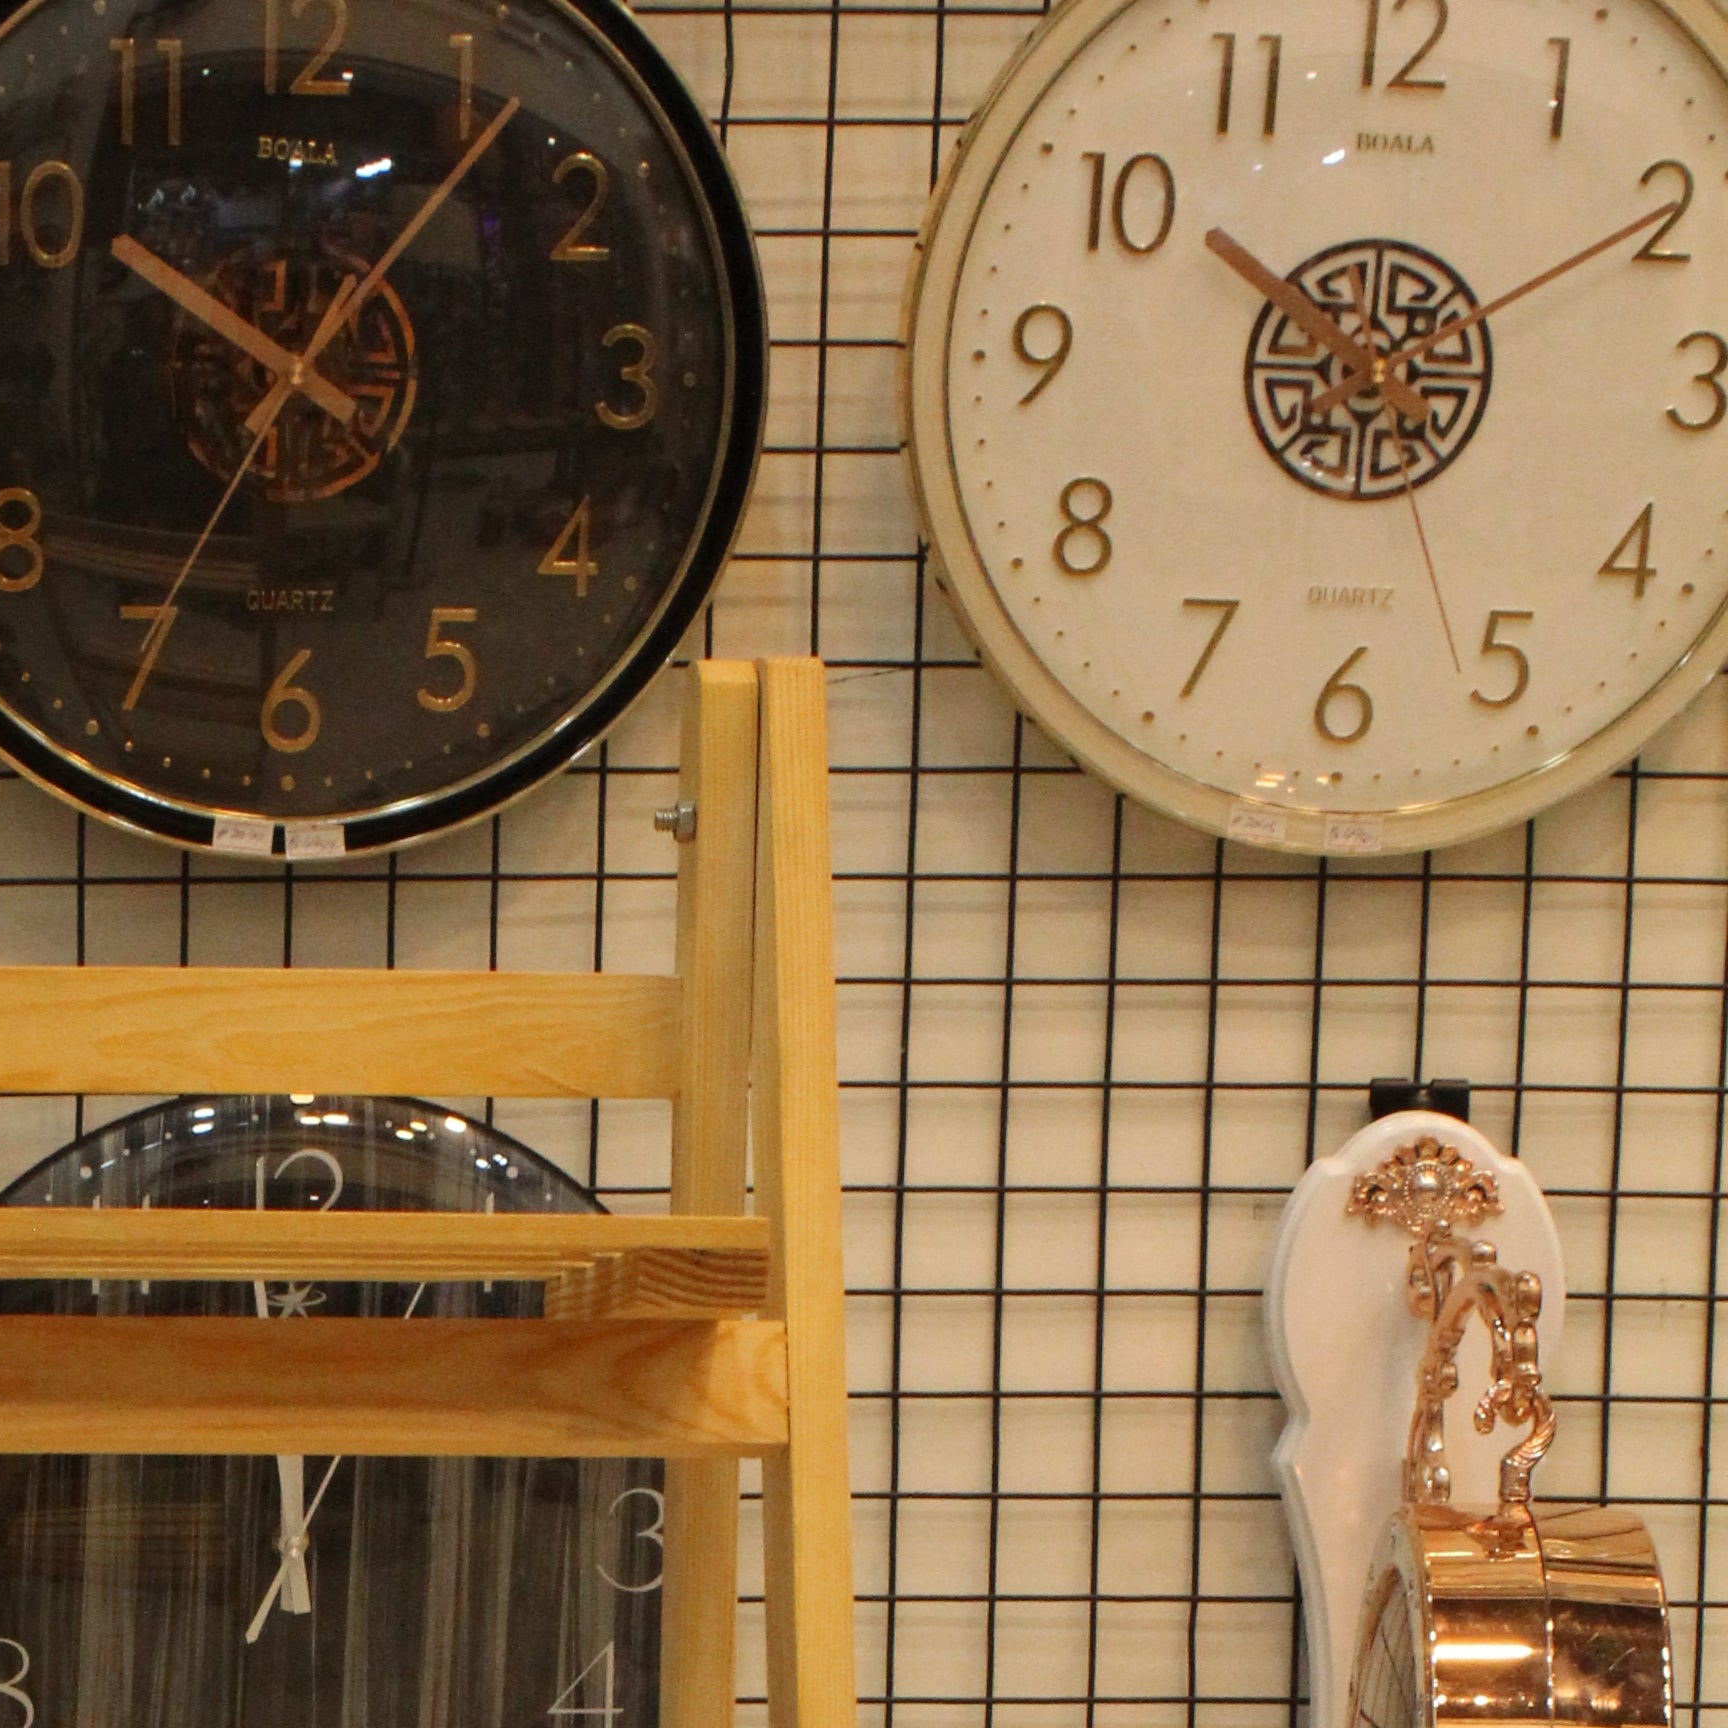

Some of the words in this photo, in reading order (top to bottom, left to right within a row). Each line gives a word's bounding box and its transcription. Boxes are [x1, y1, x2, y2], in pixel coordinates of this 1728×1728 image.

[109, 36, 185, 148] 11
[260, 0, 352, 97] 12
[447, 32, 475, 142] 1
[1210, 31, 1284, 140] 11
[1359, 0, 1449, 91] 12
[1544, 37, 1573, 142] 1
[1354, 131, 1436, 157] BOALA
[550, 151, 612, 264] 2
[1081, 150, 1177, 257] 10
[1630, 158, 1696, 265] 2
[593, 322, 659, 432] 3
[1010, 300, 1074, 407] 9
[1665, 330, 1728, 434] 3
[536, 494, 601, 599] 4
[1051, 475, 1115, 578] 8
[1597, 501, 1658, 602] 4
[247, 588, 336, 613] QUARTZ
[1306, 584, 1397, 608] QUARTZ
[118, 604, 180, 713] 7
[415, 607, 480, 715] 5
[1180, 597, 1242, 701] 7
[1313, 644, 1375, 746] 6
[1470, 608, 1535, 711] 5
[259, 648, 322, 756] 6
